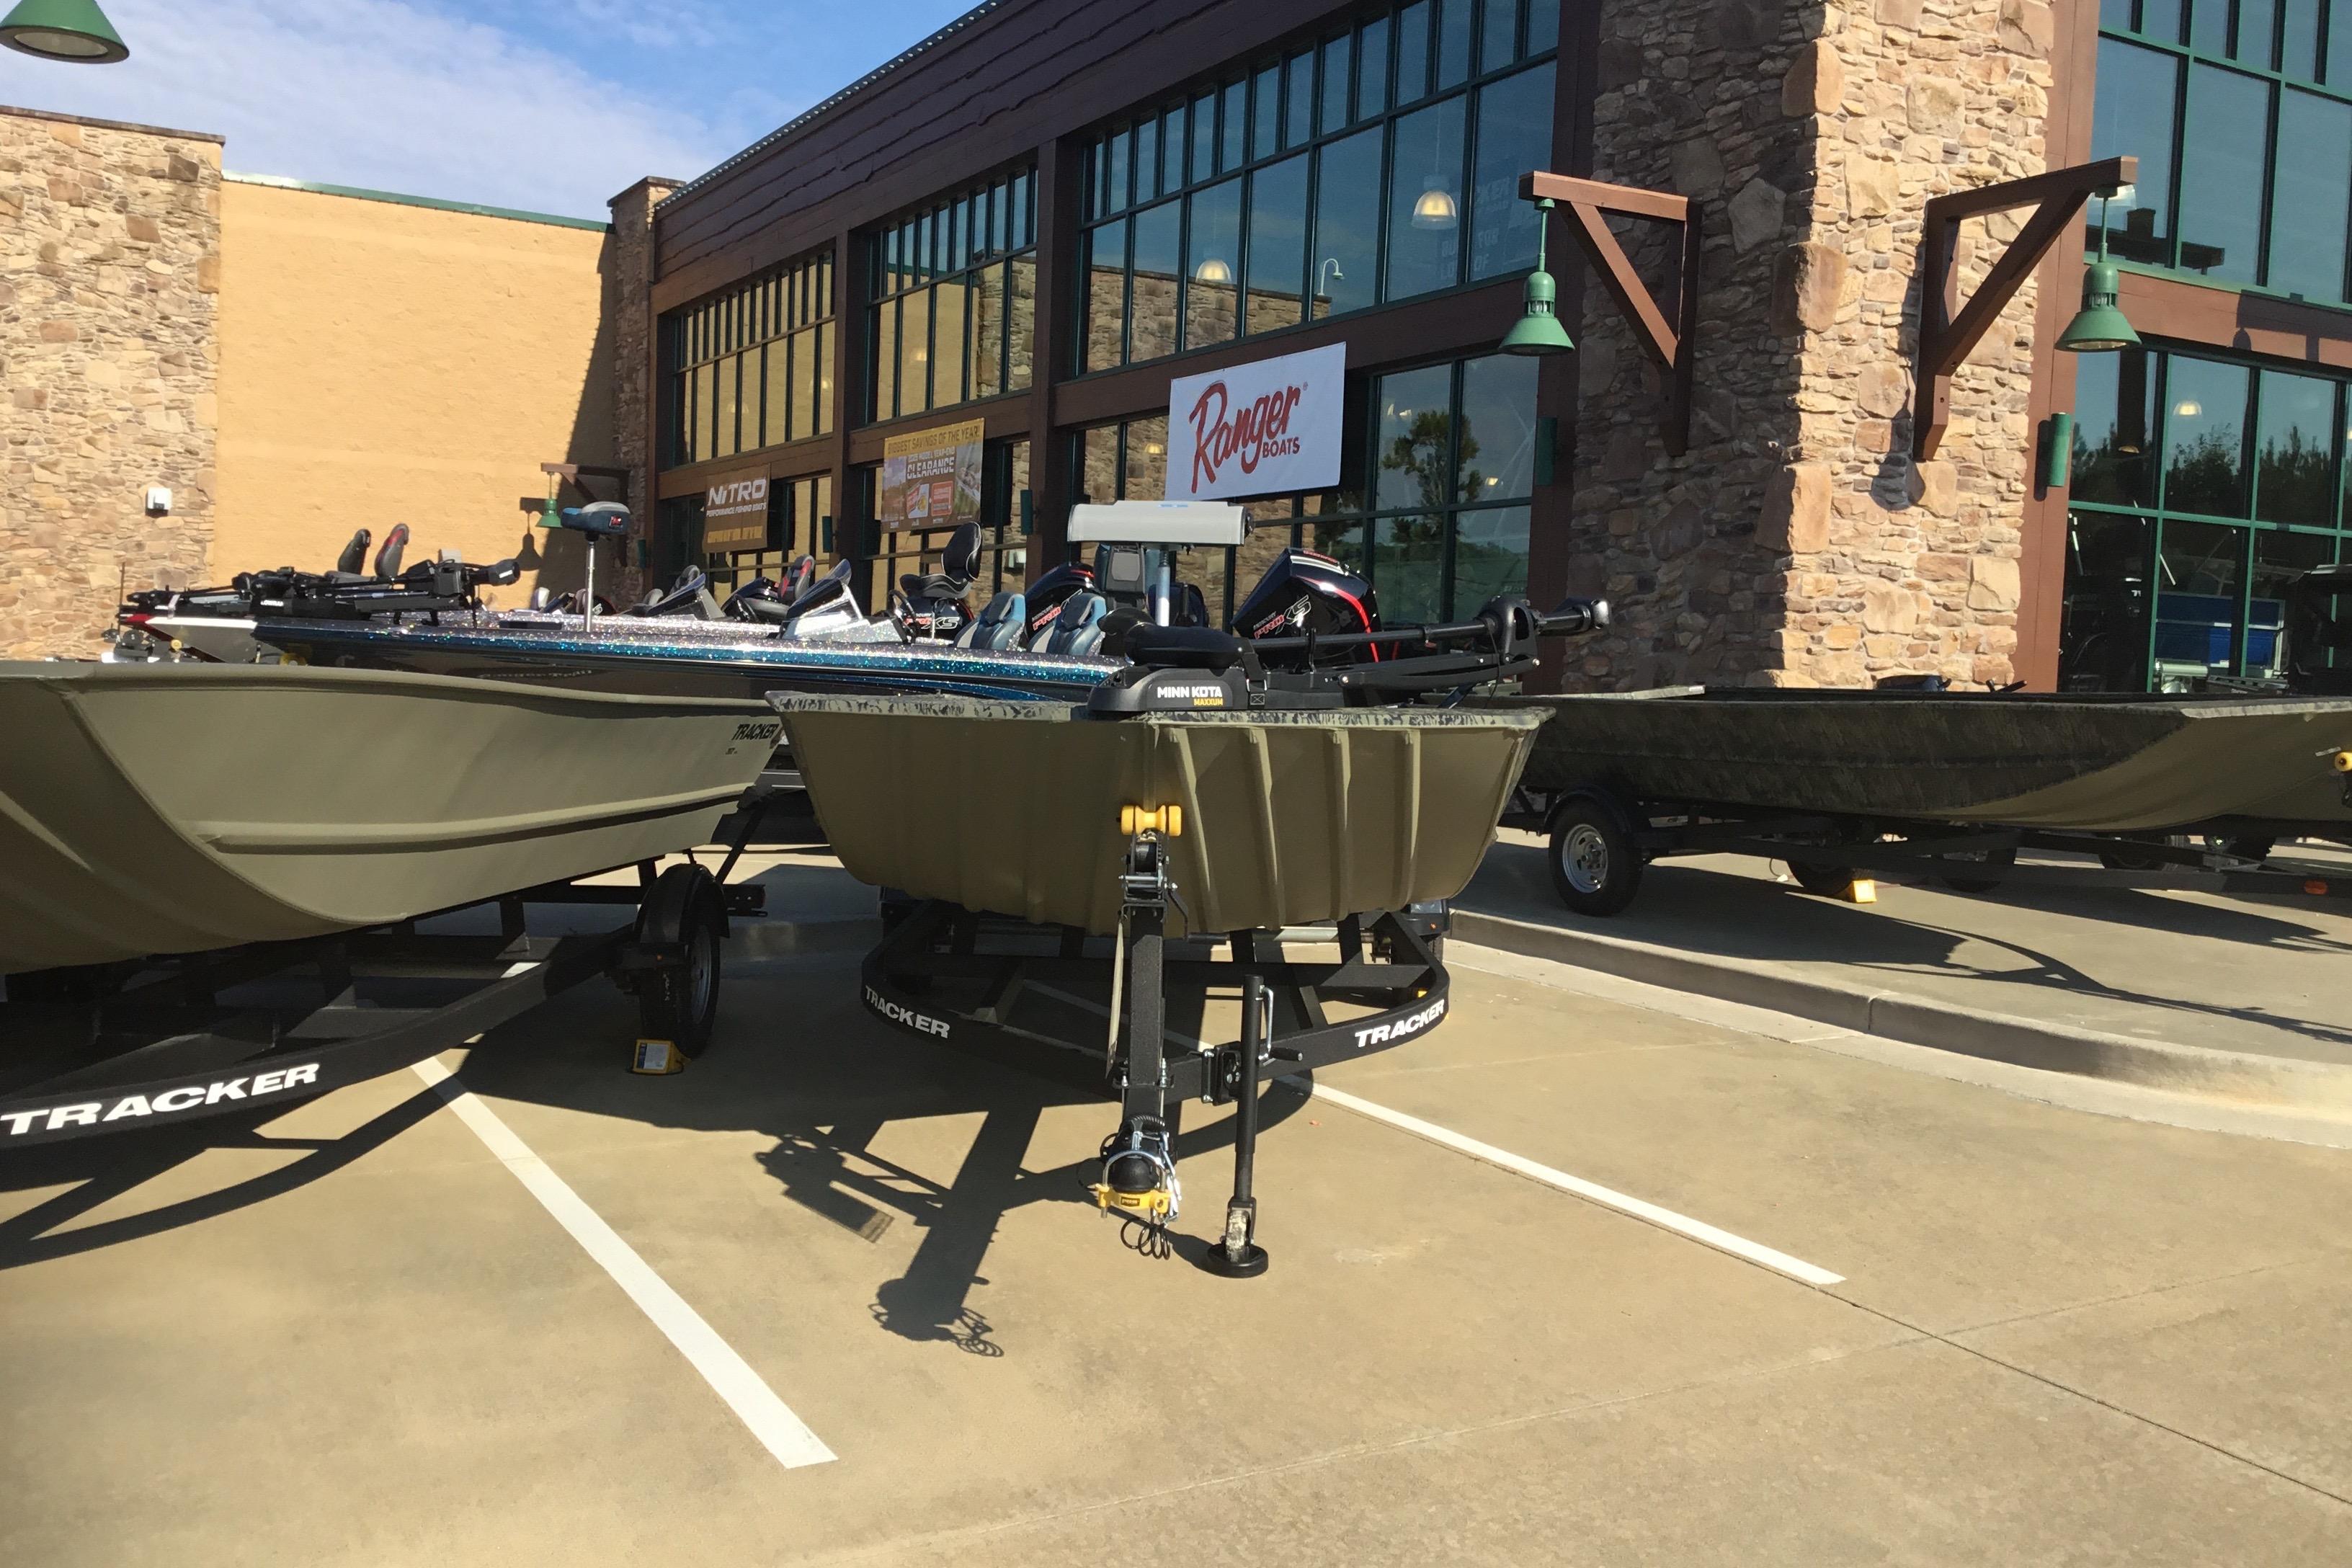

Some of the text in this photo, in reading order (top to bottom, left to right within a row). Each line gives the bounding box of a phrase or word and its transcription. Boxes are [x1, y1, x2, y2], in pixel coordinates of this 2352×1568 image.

[912, 435, 937, 450] SAVINGS
[938, 432, 948, 445] OF
[948, 429, 960, 442] THE
[961, 425, 981, 439] YEAR!
[1190, 380, 1301, 494] Ranger
[1262, 437, 1301, 458] BOATS
[906, 456, 955, 480] CLEARANCE
[1157, 685, 1224, 698] MINN KOTA
[1193, 698, 1224, 706] MAXXUM
[731, 723, 780, 741] TRACKER
[865, 984, 950, 1038] TRACKER
[1354, 998, 1445, 1048] TRACKER
[0, 1063, 320, 1136] TRACKER
